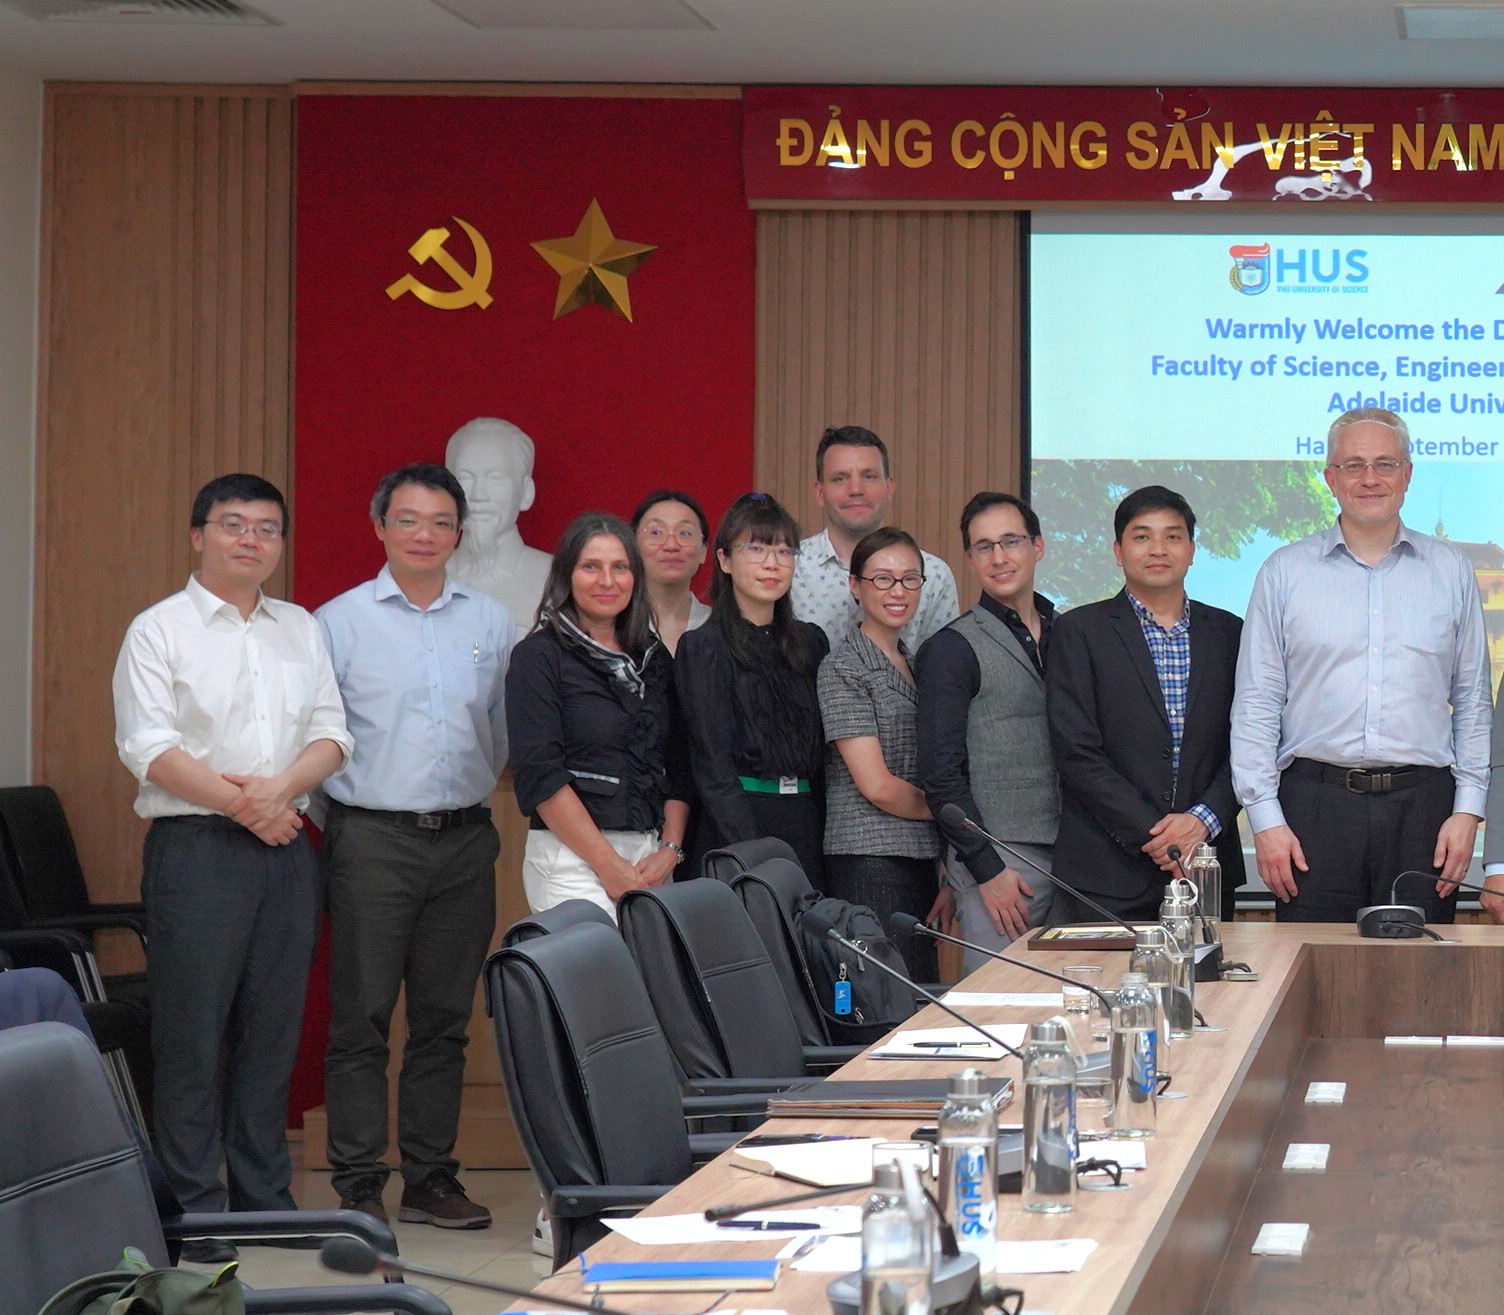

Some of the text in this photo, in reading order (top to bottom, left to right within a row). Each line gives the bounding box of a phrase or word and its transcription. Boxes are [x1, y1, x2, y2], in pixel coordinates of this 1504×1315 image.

[777, 107, 931, 167] ĐẢNG
[952, 113, 1107, 180] CỘNG
[1126, 108, 1234, 170] SẢN
[1256, 110, 1374, 182] VIỆT
[1276, 249, 1370, 283] HUS
[1292, 285, 1330, 293] UNIVERSITY
[1331, 285, 1340, 293] OF
[1342, 285, 1369, 293] SCIENCE
[1205, 316, 1307, 346] Warmly
[1314, 317, 1436, 341] Welcome
[1442, 317, 1485, 341] the
[1151, 353, 1243, 382] Faculty
[1249, 353, 1277, 377] of
[1284, 354, 1388, 382] Science,
[1327, 391, 1442, 414] Adelaide
[961, 1180, 982, 1237] HUS
